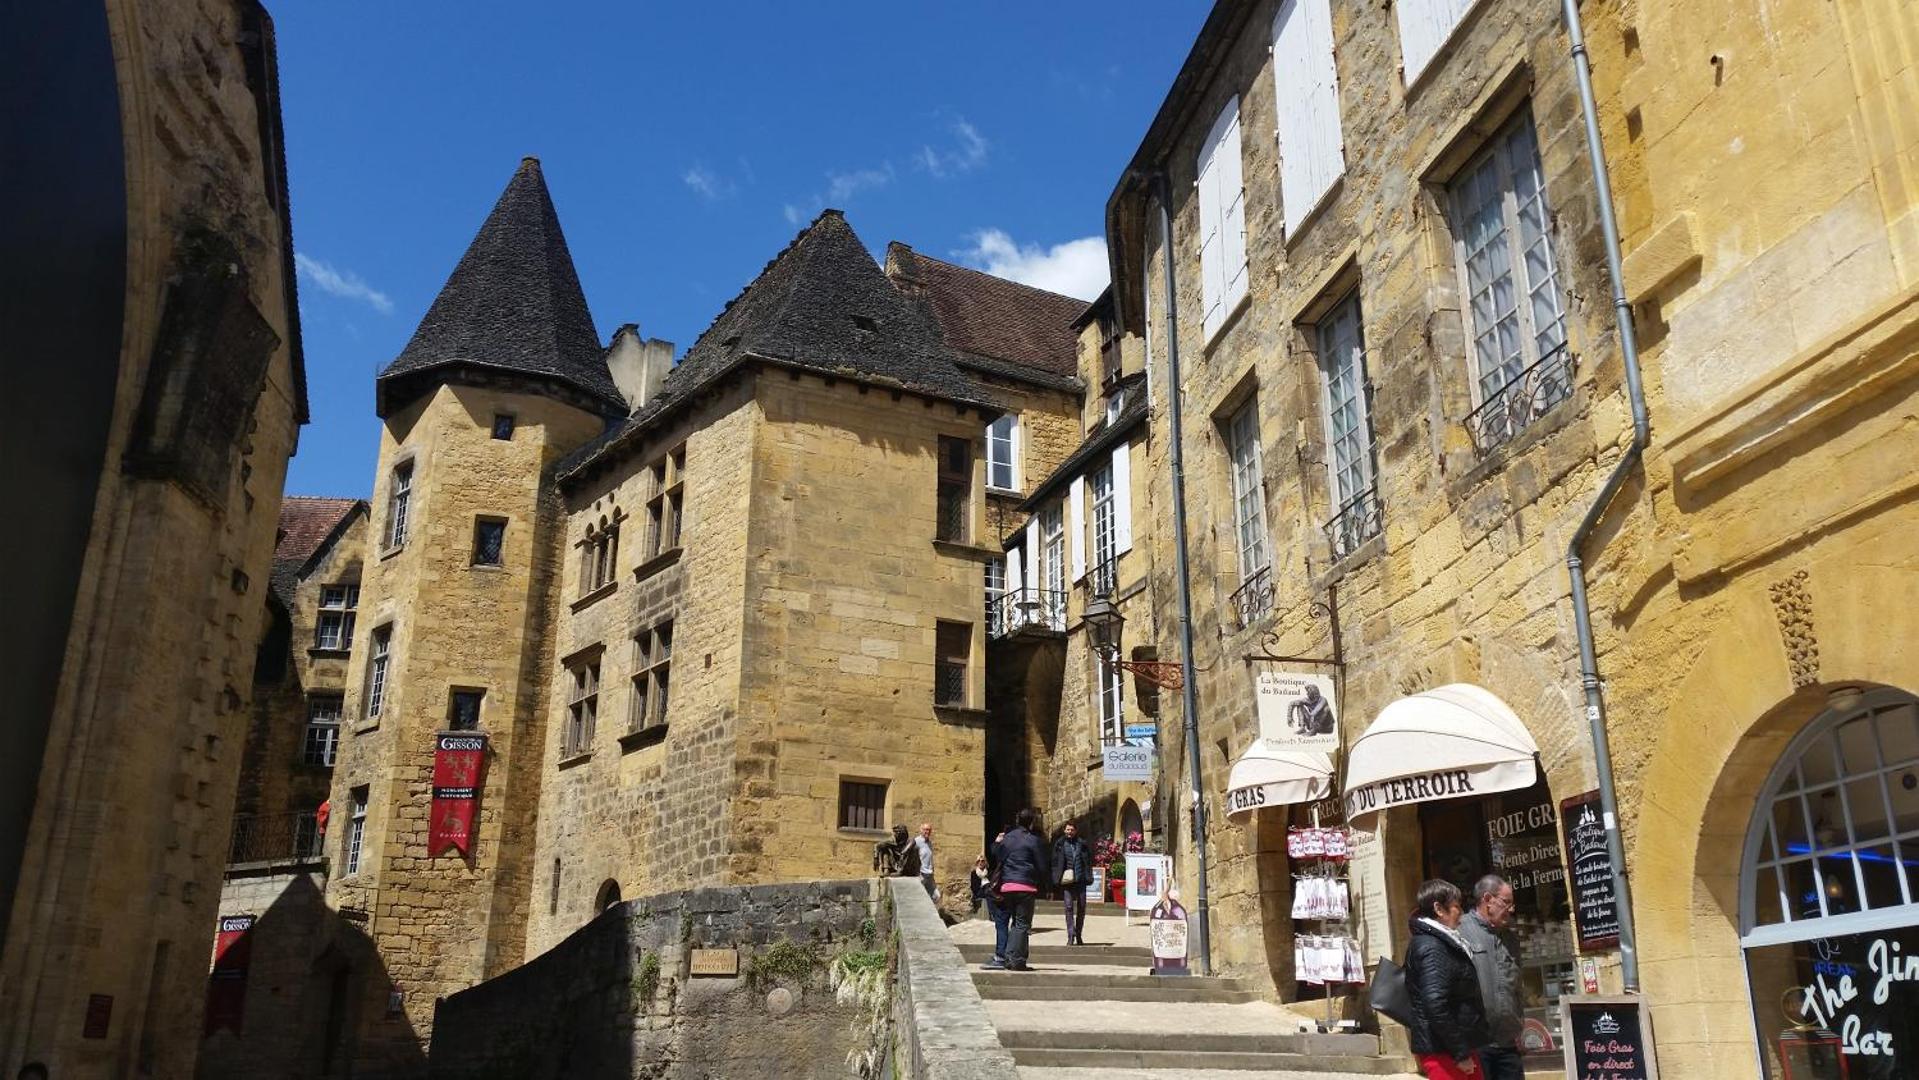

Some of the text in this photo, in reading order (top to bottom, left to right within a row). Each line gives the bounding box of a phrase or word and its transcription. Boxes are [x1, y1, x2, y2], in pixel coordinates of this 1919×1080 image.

[1272, 677, 1306, 688] Boutique
[1260, 686, 1271, 695] du
[441, 737, 482, 750] GISSON
[1108, 750, 1147, 762] Galerie
[1235, 786, 1265, 809] GRAS
[1357, 784, 1376, 811] DU
[1381, 769, 1474, 804] TERROIR
[1487, 811, 1526, 843] FOIE
[1519, 872, 1531, 888] la
[1801, 973, 1858, 1029] The
[1841, 1014, 1894, 1057] Bar
[1584, 1040, 1635, 1054] Foie Gras
[1588, 1057, 1634, 1070] en direct
